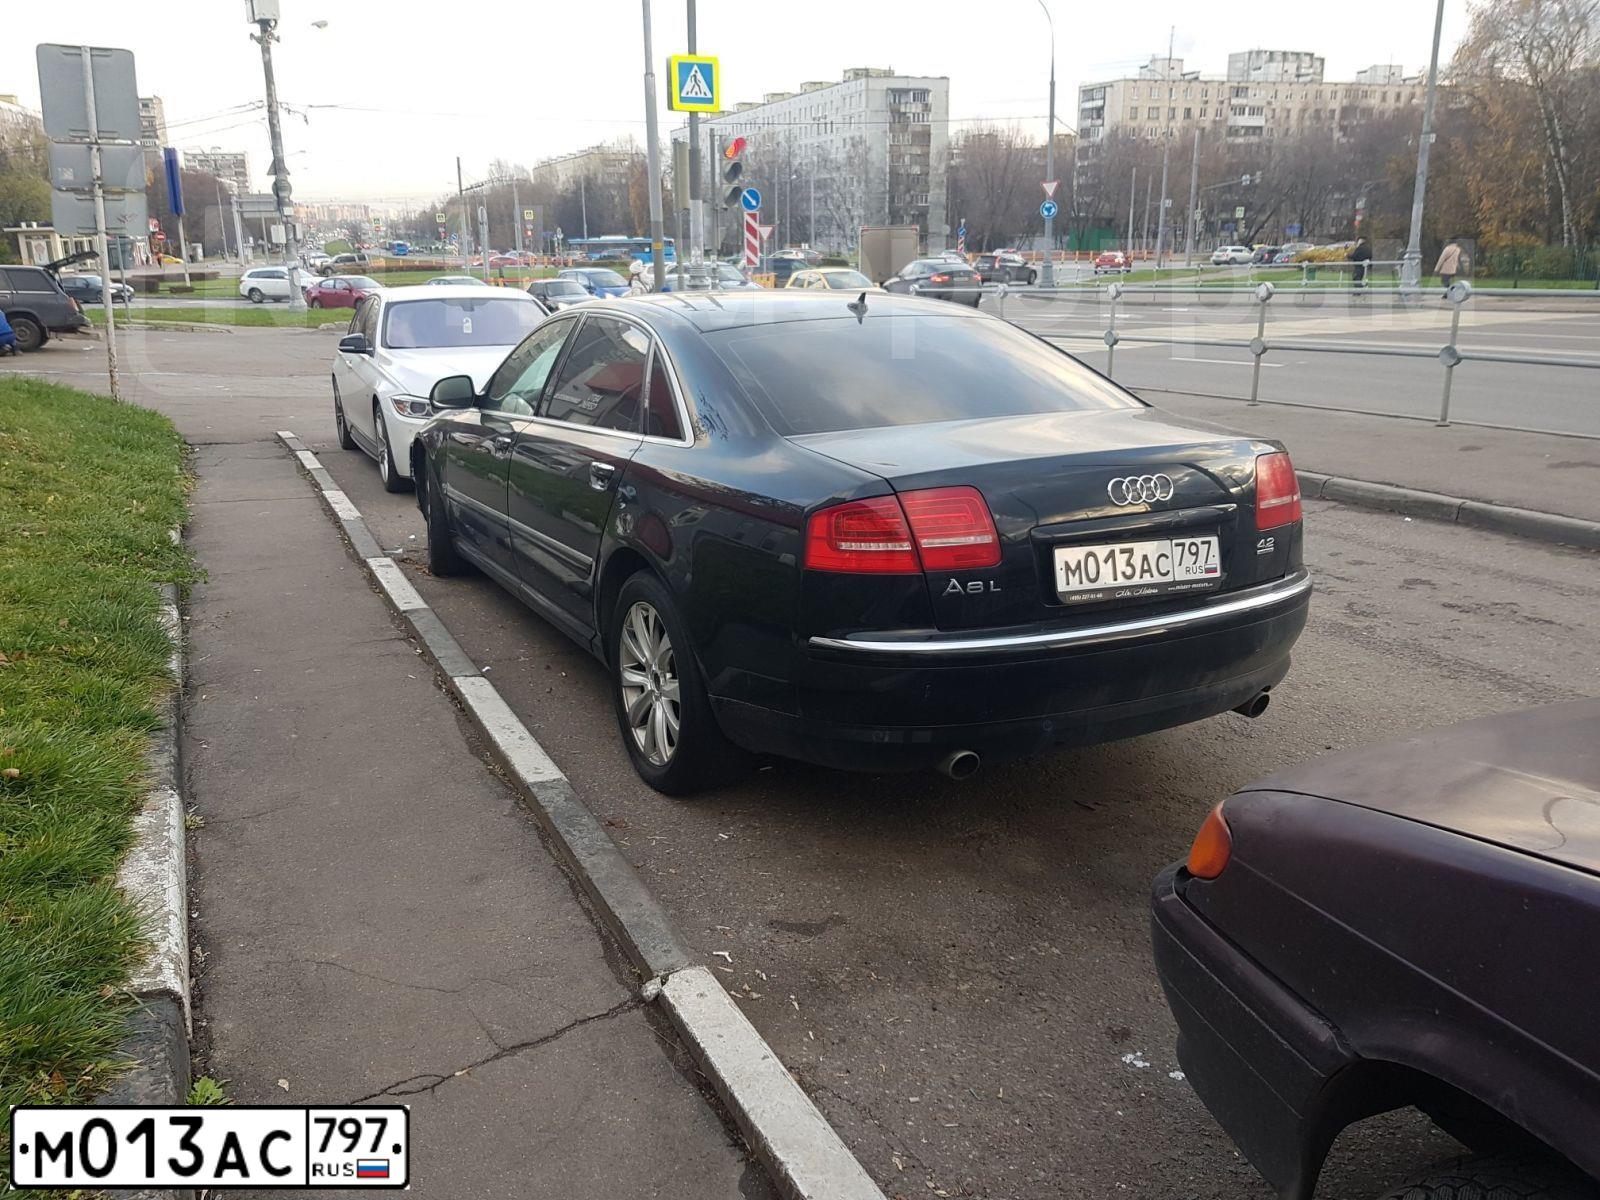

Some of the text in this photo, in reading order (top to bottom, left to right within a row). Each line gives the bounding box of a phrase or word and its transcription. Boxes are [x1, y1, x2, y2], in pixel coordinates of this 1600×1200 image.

[1065, 540, 1212, 586] М013АС 797
[1186, 565, 1204, 575] RUS
